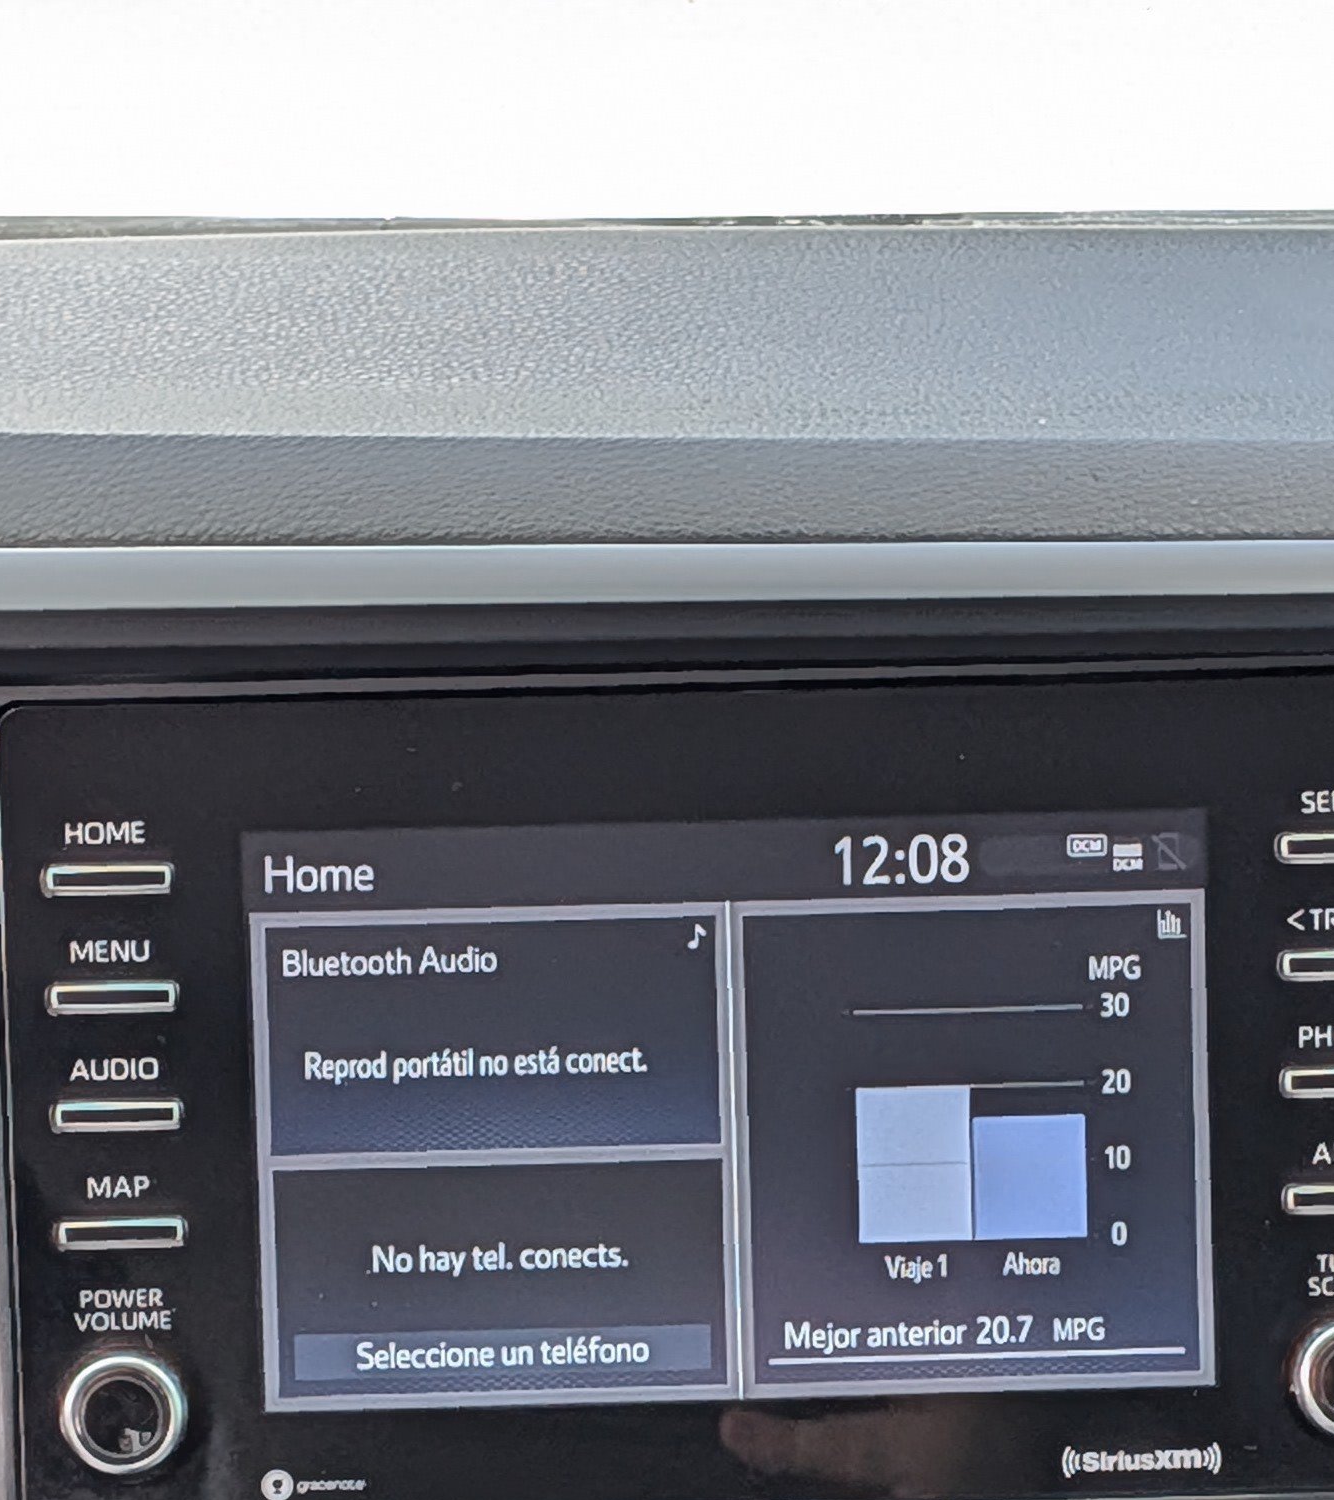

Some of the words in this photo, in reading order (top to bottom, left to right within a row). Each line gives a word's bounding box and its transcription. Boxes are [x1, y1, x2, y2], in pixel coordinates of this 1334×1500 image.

[64, 820, 146, 845] HOME
[834, 833, 970, 886] 12:08
[264, 855, 375, 894] Home
[69, 939, 150, 964] MENU
[282, 946, 413, 978] Bluetooth
[418, 945, 498, 975] Audio
[1088, 954, 1142, 981] MPG
[1100, 991, 1130, 1018] 30
[69, 1056, 159, 1082] AUDIO
[304, 1050, 388, 1086] Reprod
[392, 1047, 474, 1085] portátil
[479, 1054, 509, 1077] no
[513, 1045, 560, 1077] está
[564, 1047, 648, 1075] conect.
[1101, 1068, 1132, 1095] 20
[1104, 1144, 1131, 1170] 10
[86, 1175, 150, 1200] MAP
[1111, 1221, 1128, 1246] 0
[371, 1244, 414, 1273] No
[418, 1244, 467, 1278] hay
[471, 1242, 514, 1271] tel.
[519, 1243, 629, 1270] conects.
[883, 1254, 934, 1285] Viaje
[936, 1253, 948, 1278] 1
[1002, 1251, 1061, 1277] Ahora
[79, 1287, 164, 1309] POWER
[73, 1310, 172, 1332] VOLUME
[784, 1321, 862, 1355] Mejor
[866, 1319, 968, 1348] anterior
[976, 1314, 1034, 1345] 20.7
[1053, 1316, 1106, 1343] MPG
[356, 1341, 496, 1371] Seleccione
[500, 1345, 534, 1367] un
[539, 1335, 650, 1366] teléfono
